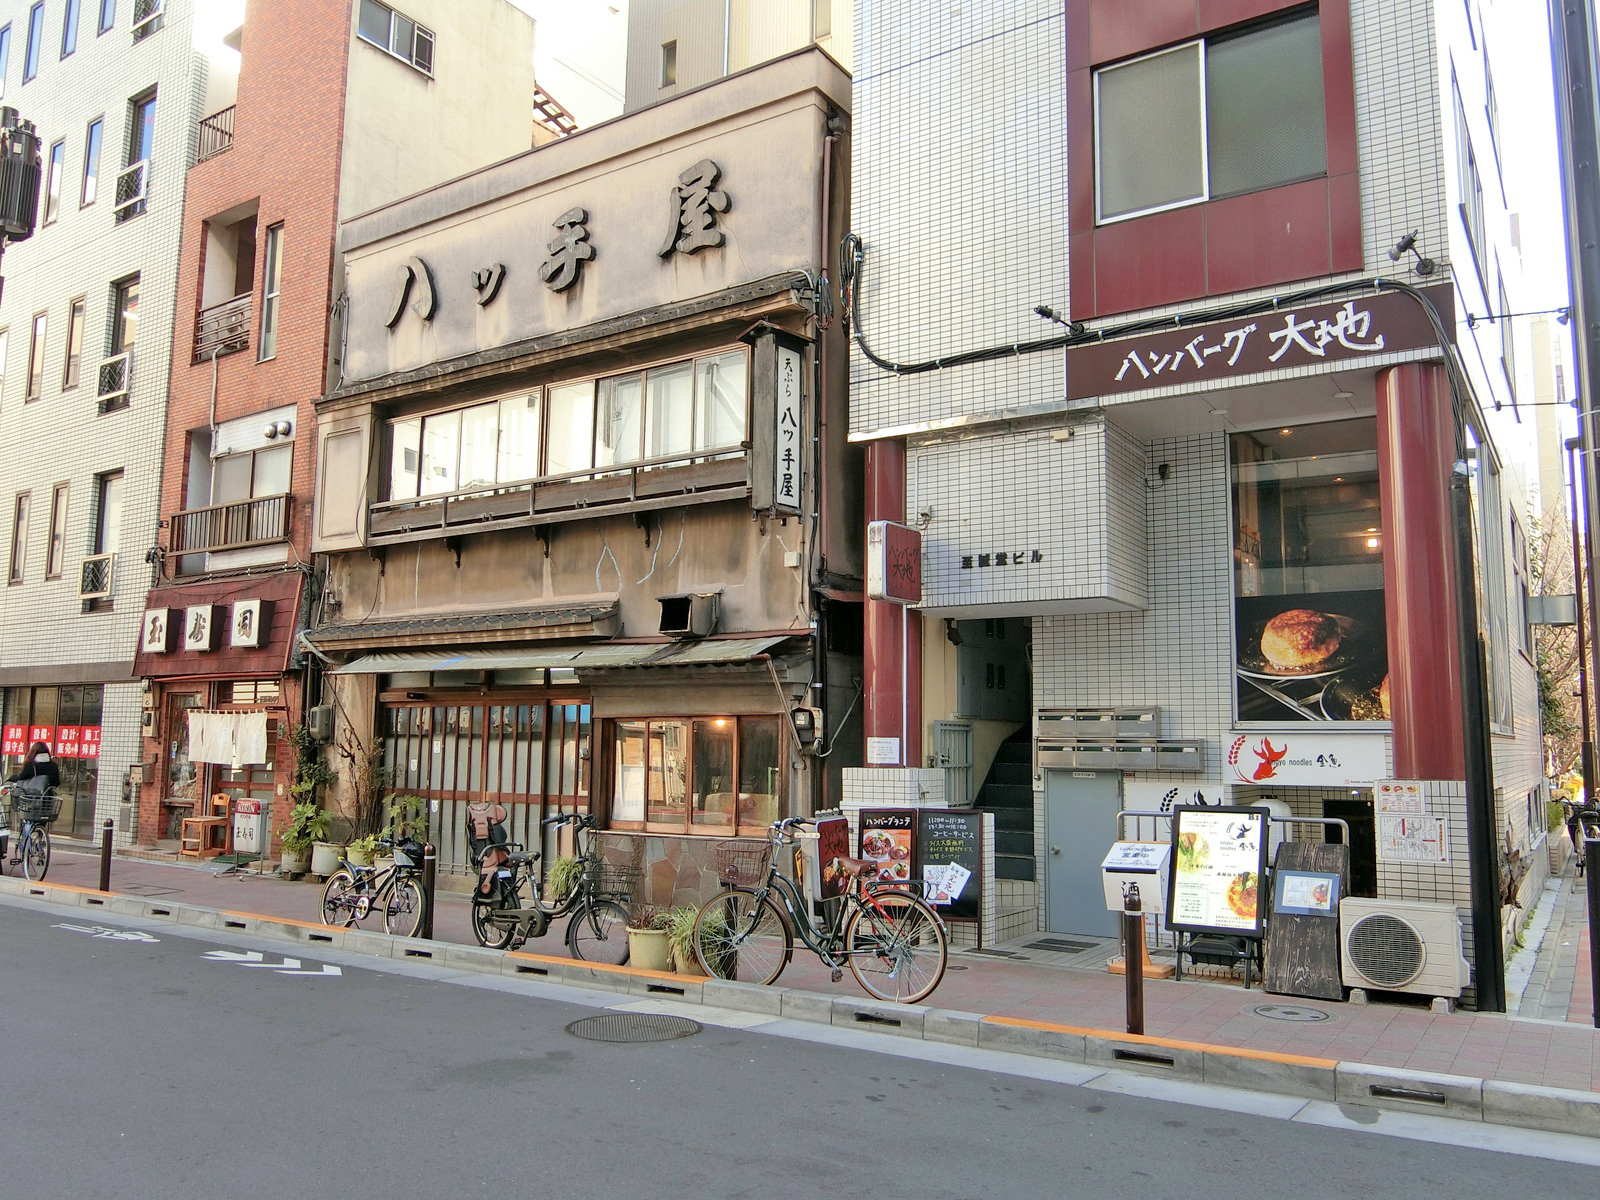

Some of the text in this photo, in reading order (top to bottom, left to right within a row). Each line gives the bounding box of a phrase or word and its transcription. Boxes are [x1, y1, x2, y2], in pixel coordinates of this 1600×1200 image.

[1114, 301, 1385, 381] ハンバーグ 大地
[783, 358, 794, 398] 天ぷら
[147, 607, 254, 646] 玉寿司
[1288, 756, 1313, 767] noodles
